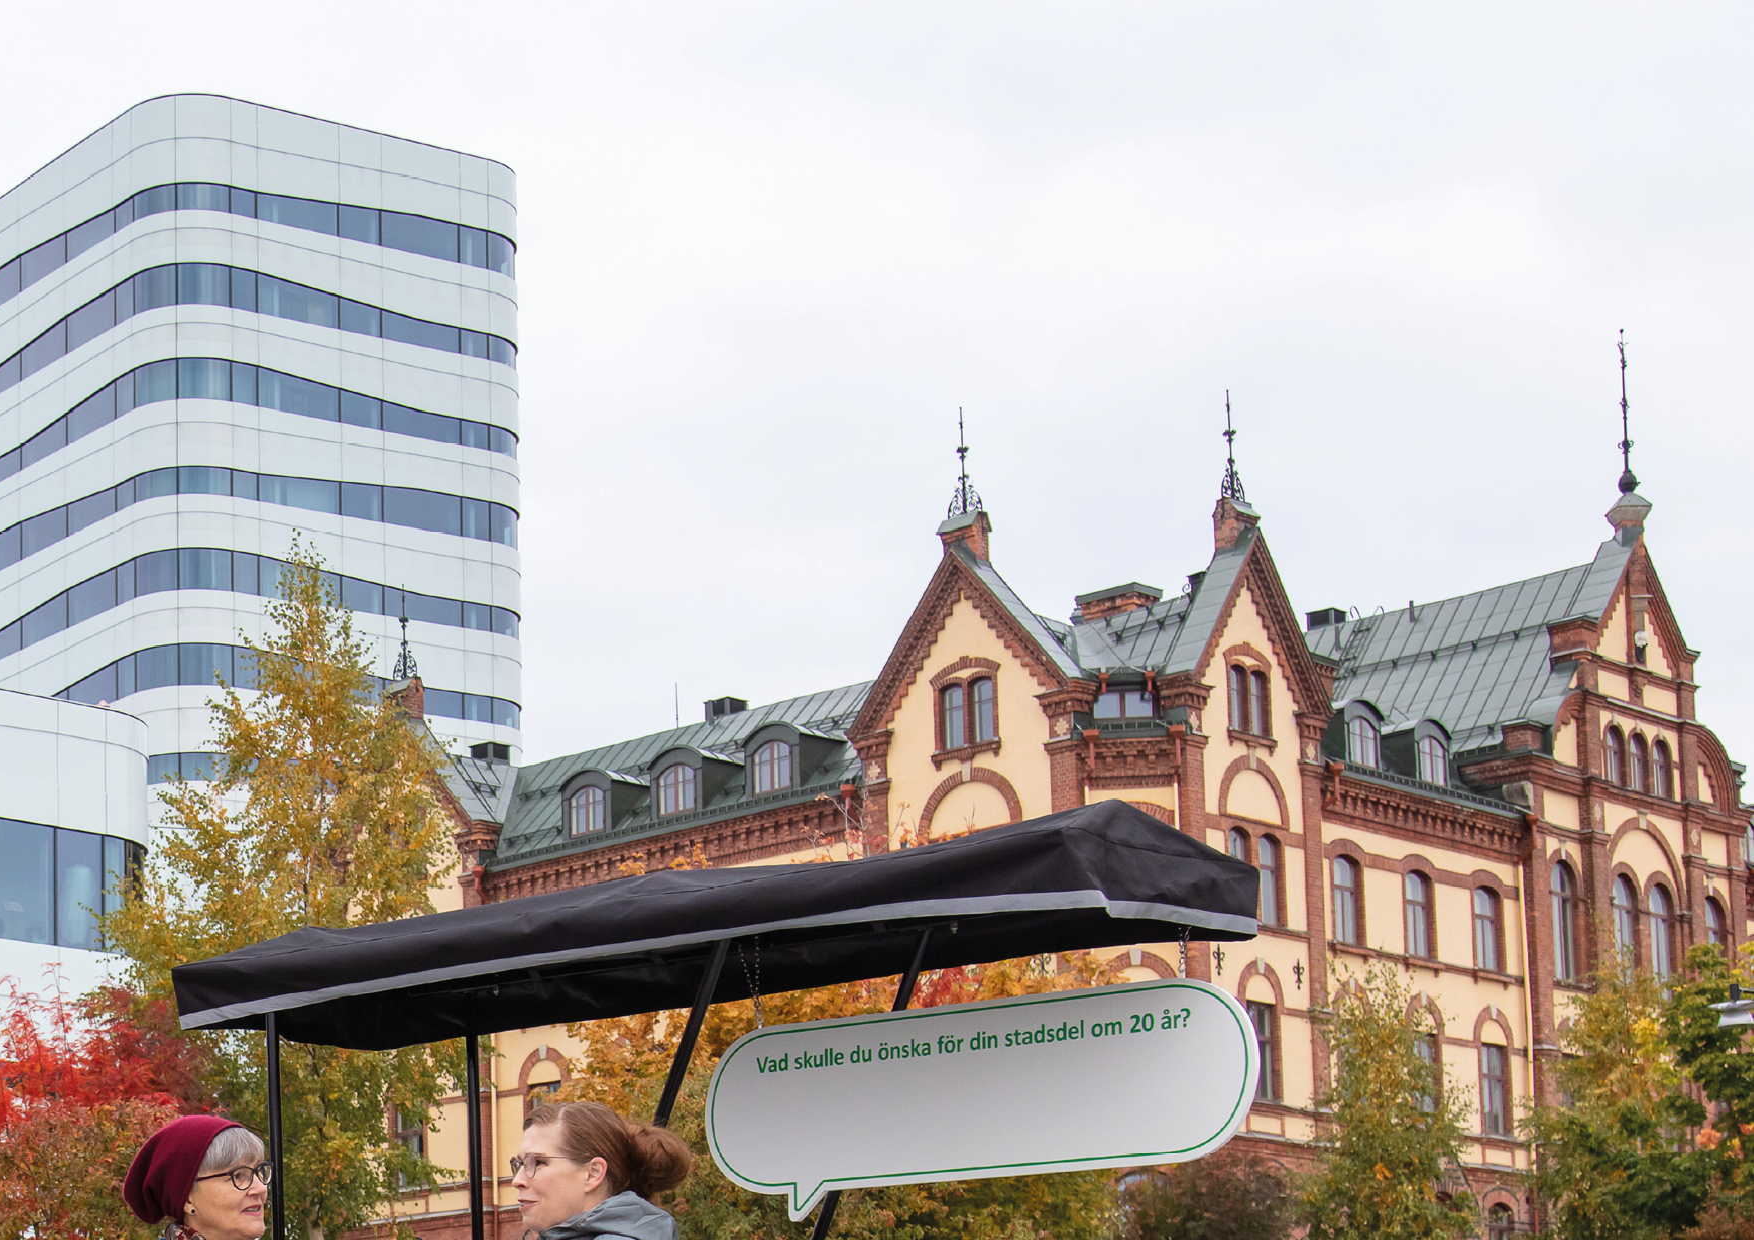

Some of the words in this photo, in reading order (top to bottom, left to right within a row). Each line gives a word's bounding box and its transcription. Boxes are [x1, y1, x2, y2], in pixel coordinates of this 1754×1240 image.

[756, 1053, 789, 1074] Vad
[794, 1048, 845, 1070] skulle
[850, 1045, 872, 1064] du
[878, 1038, 931, 1060] önska
[938, 1035, 964, 1054] för
[969, 1031, 998, 1050] din
[1004, 1019, 1085, 1047] stadsdel
[1091, 1021, 1123, 1037] om
[1130, 1012, 1155, 1033] 20
[1161, 1008, 1191, 1030] år?
